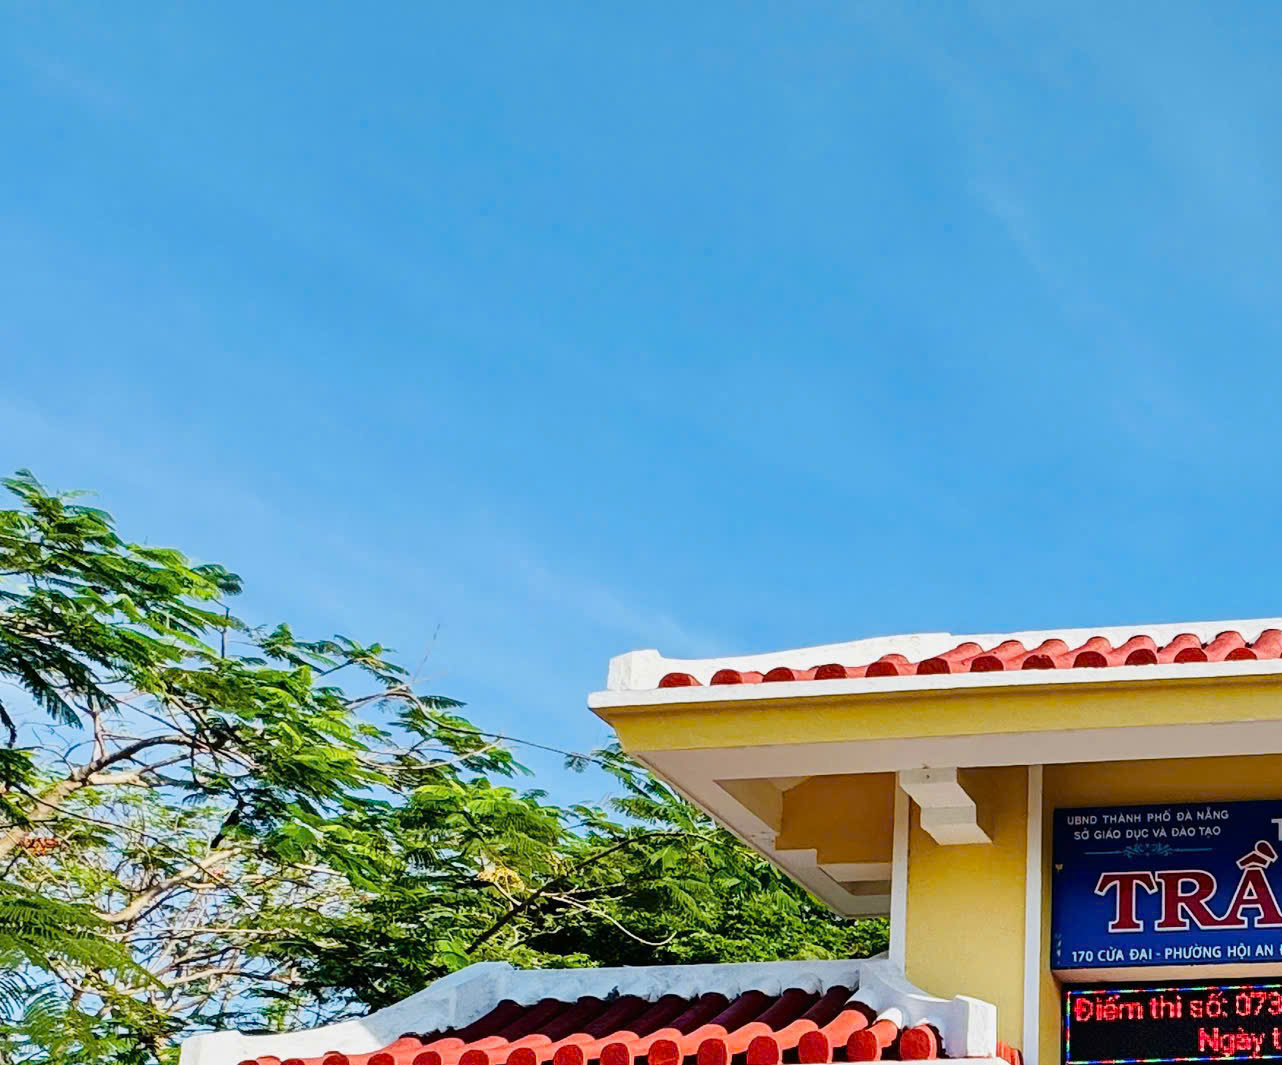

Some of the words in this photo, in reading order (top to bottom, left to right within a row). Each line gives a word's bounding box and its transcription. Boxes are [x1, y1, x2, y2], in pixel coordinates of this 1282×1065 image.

[1067, 815, 1097, 826] UBND
[1102, 811, 1142, 824] THÀNH
[1147, 808, 1171, 823] PHỐ
[1176, 809, 1193, 821] ĐÀ
[1073, 827, 1090, 840] SỞ
[1094, 827, 1121, 840] GIÁO
[1126, 829, 1149, 841] DỤC
[1152, 826, 1167, 838] VÀ
[1198, 826, 1221, 839] TẠO
[1072, 950, 1094, 962] 170
[1097, 945, 1125, 962] CỬA
[1129, 948, 1153, 963] ĐẠI
[1164, 943, 1222, 960] PHƯỜNG
[1227, 942, 1251, 960] HỘI
[1255, 943, 1274, 957] AN
[1073, 994, 1144, 1022] Điểm
[1198, 1026, 1265, 1058] Ngày
